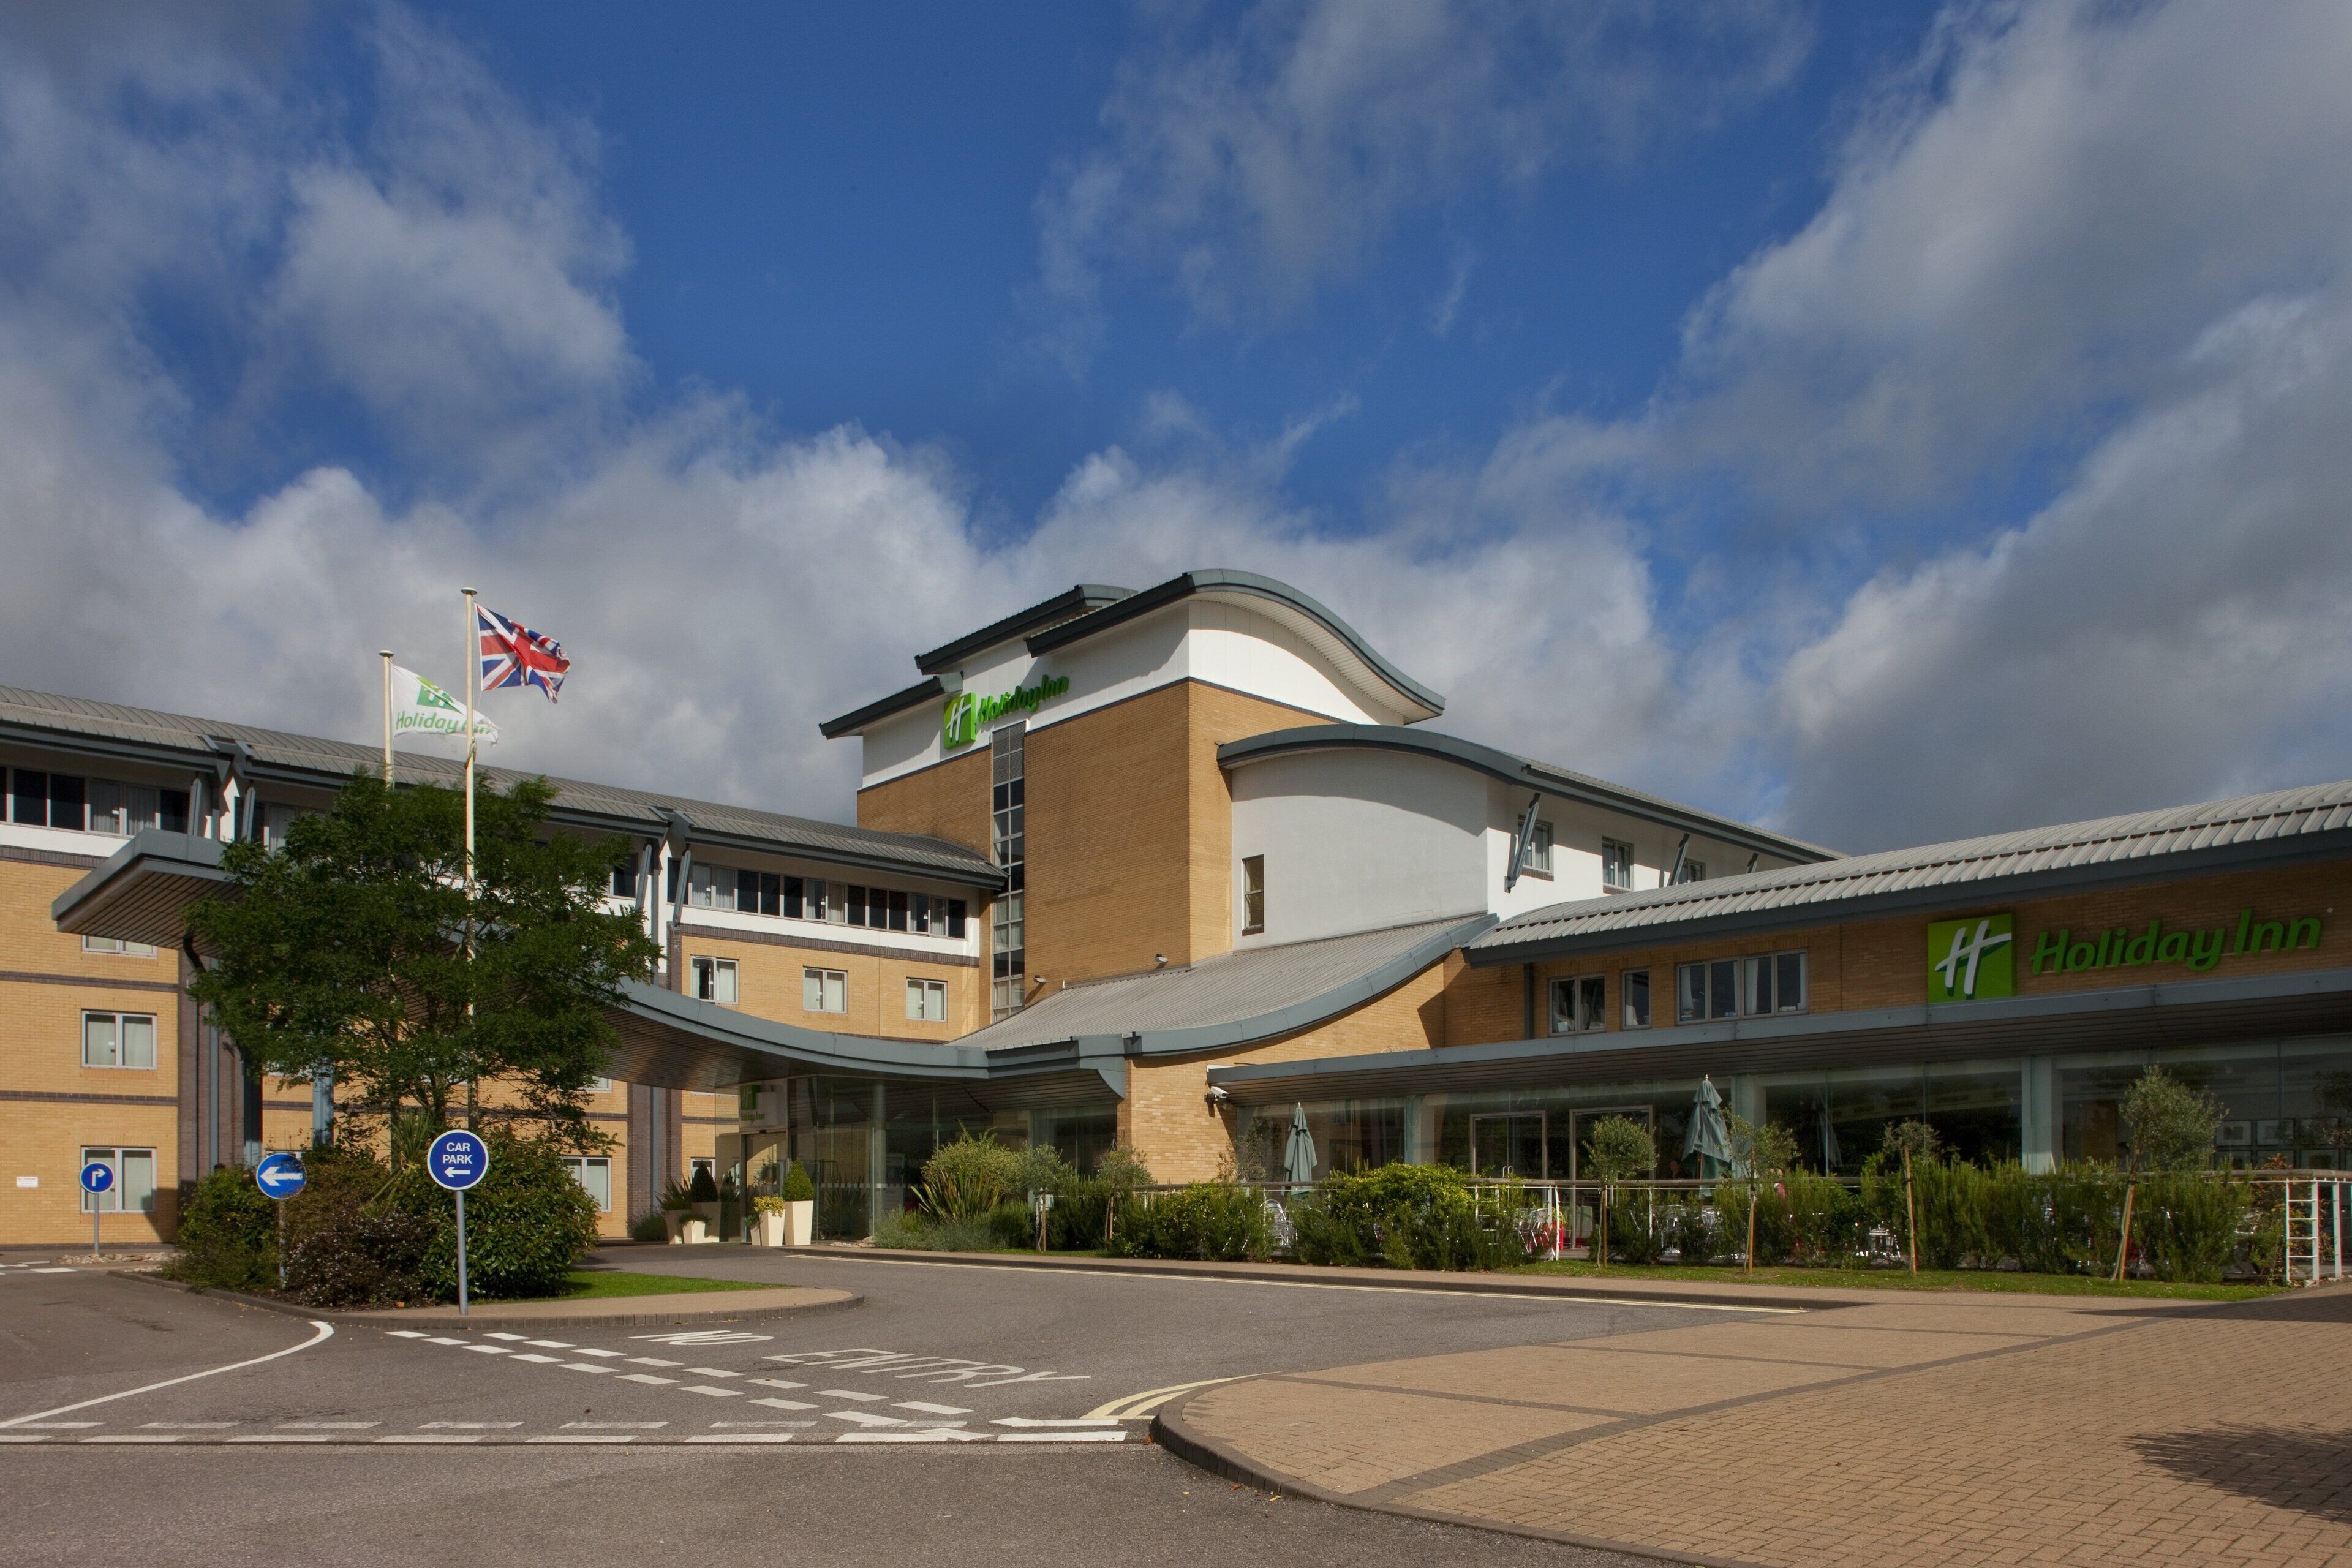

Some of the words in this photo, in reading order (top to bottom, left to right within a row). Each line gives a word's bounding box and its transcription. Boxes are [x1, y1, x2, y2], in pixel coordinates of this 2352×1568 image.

[978, 686, 1041, 723] Holiday
[1042, 674, 1069, 700] Inn
[396, 711, 459, 734] Holiday
[2029, 919, 2226, 975] Holiday
[2234, 908, 2322, 956] Inn
[442, 1155, 473, 1164] PARK
[446, 1142, 470, 1152] CAR
[628, 1330, 775, 1346] NO
[761, 1348, 1091, 1388] ENTRY
